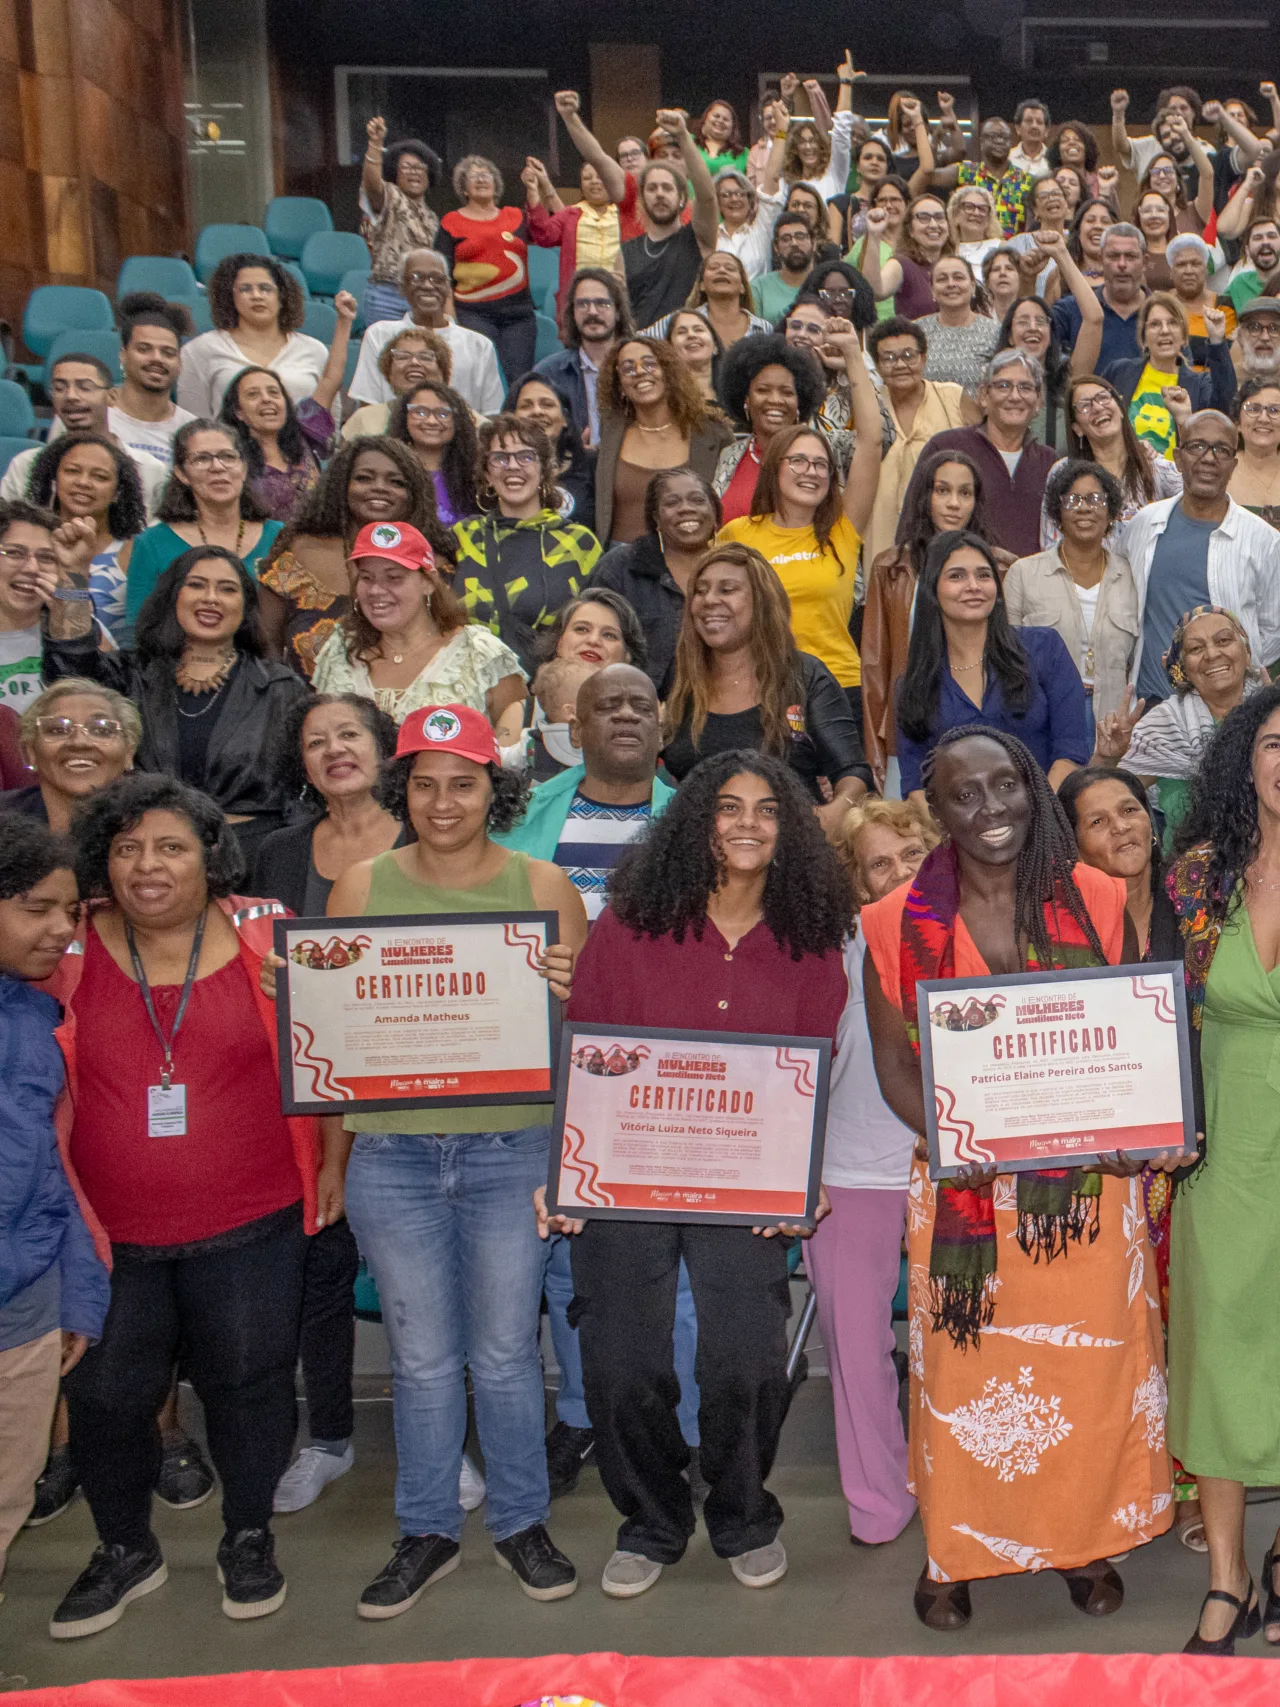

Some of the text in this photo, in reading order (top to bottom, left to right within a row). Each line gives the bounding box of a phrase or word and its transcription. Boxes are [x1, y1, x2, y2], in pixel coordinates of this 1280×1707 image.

[436, 937, 447, 945] DE
[381, 945, 454, 957] MULHERES
[432, 957, 454, 965] Neto
[356, 971, 487, 1000] CERTIFICADO
[1067, 992, 1077, 1001] DE
[1015, 1000, 1085, 1017] MULHERES
[374, 1012, 470, 1024] Amanda Matheus
[1064, 1012, 1085, 1021] Neto
[992, 1025, 1117, 1060] CERTIFICADO
[711, 1054, 721, 1062] DE
[657, 1058, 727, 1073] MULHERES
[1014, 1070, 1045, 1080] Elaine
[1048, 1066, 1085, 1077] Pereira
[1087, 1064, 1106, 1074] dos
[1108, 1061, 1143, 1072] Santos
[705, 1073, 726, 1081] Neto
[629, 1084, 754, 1115] CERTIFICADO
[620, 1121, 757, 1138] Vitória Luiza Neto Siqueira
